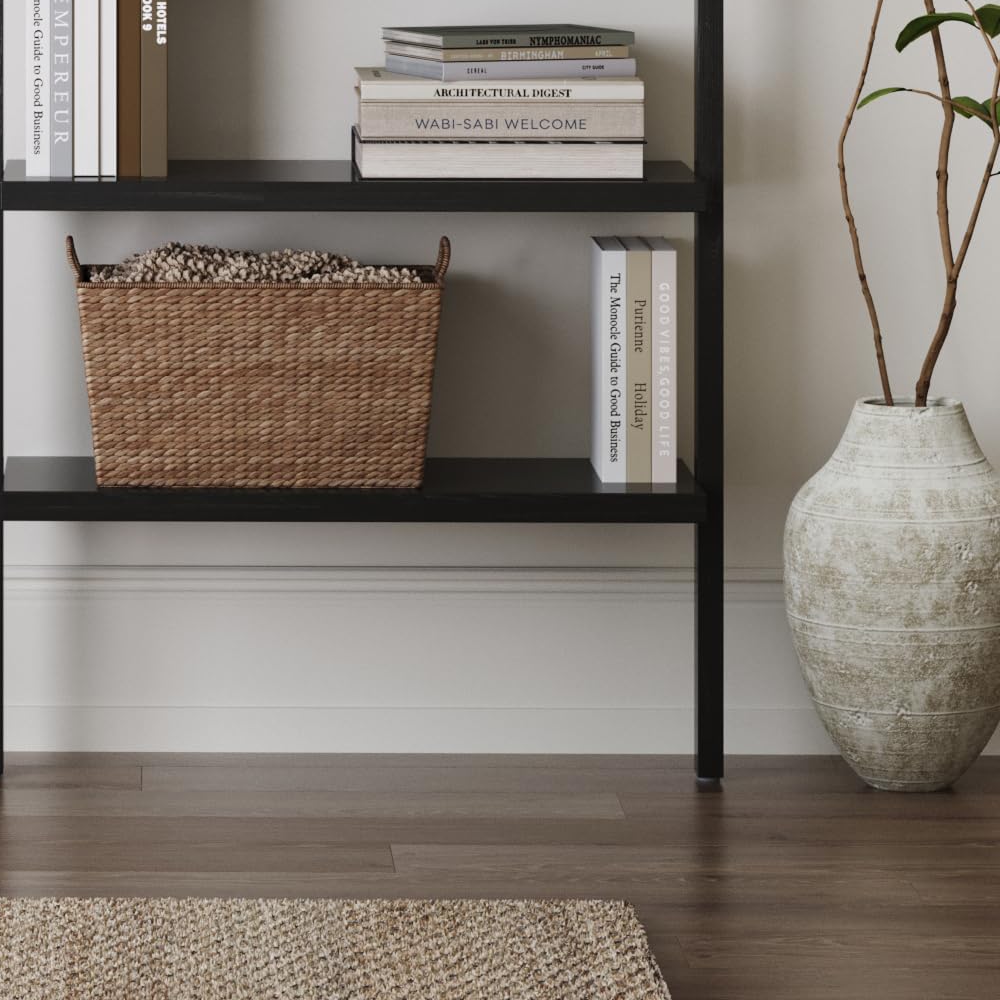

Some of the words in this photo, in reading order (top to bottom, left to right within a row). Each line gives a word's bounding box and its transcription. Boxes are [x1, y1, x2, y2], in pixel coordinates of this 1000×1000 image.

[142, 23, 153, 32] 9
[156, 2, 167, 45] HOTELS
[33, 29, 44, 61] Guide
[500, 51, 564, 60] BIRMINGHAM
[529, 35, 601, 46] NYMPHOMANIAC
[33, 65, 42, 75] to
[33, 78, 44, 107] Good
[433, 88, 530, 98] ARCHITECTURAL
[531, 88, 572, 98] DIGEST
[33, 111, 44, 154] Business
[415, 118, 499, 130] WABI-SABI
[505, 118, 587, 130] WELCOME
[610, 273, 621, 293] The
[610, 297, 621, 340] Monocle
[660, 283, 669, 325] GOOD
[634, 300, 646, 353] Purienne
[610, 343, 621, 373] Guide
[610, 376, 618, 386] to
[610, 389, 621, 417] Good
[630, 383, 647, 431] Holiday
[660, 379, 669, 420] GOOD
[610, 421, 621, 462] Business
[660, 427, 669, 457] LIFE
